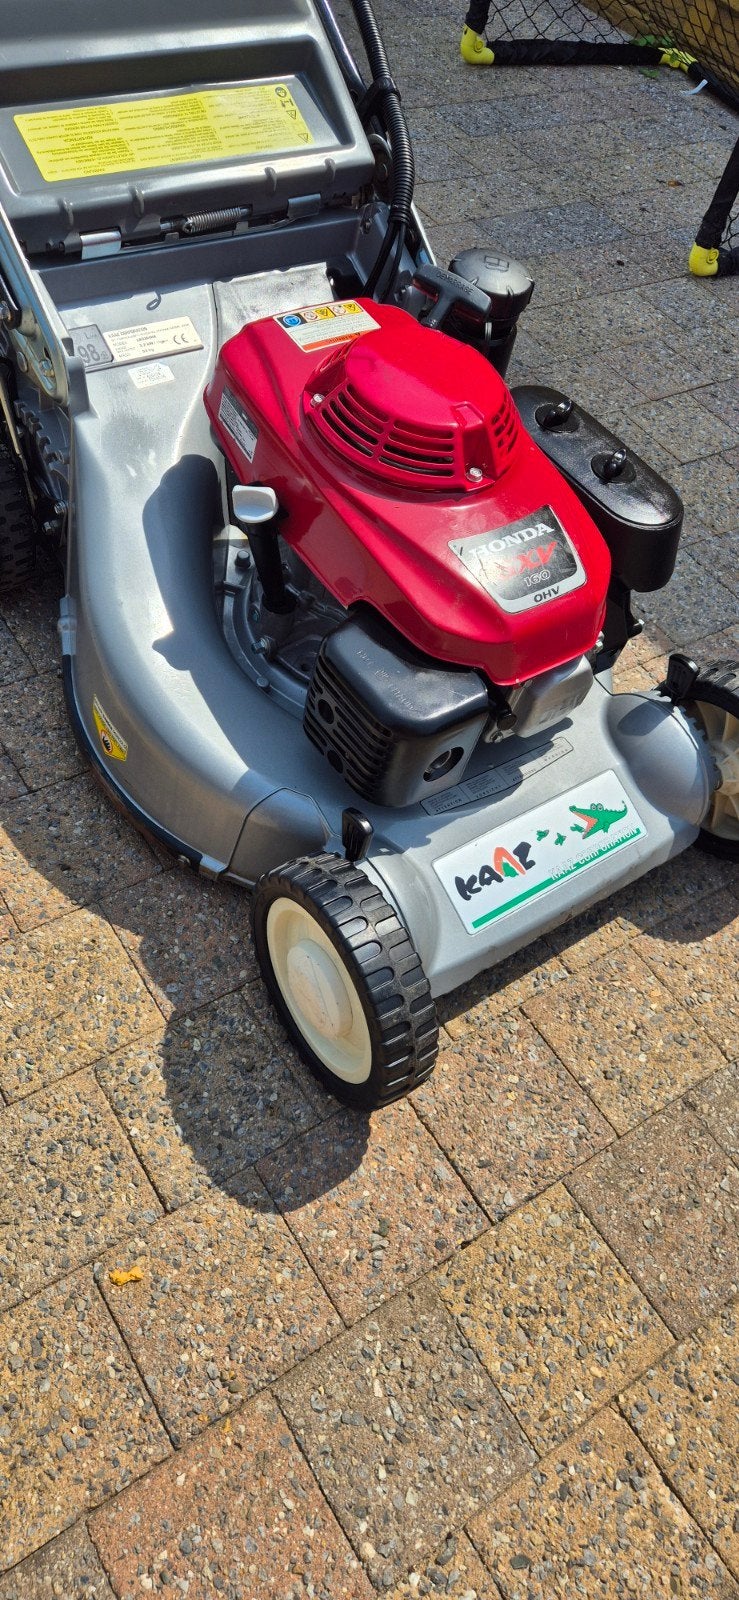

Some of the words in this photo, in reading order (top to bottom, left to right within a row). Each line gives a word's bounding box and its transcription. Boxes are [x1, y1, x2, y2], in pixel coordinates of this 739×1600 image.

[77, 343, 100, 363] 98
[468, 522, 555, 560] HONDA
[523, 569, 551, 587] 160
[533, 585, 560, 603] OHV
[577, 825, 637, 866] CORPORATION
[454, 841, 536, 901] KAAZ
